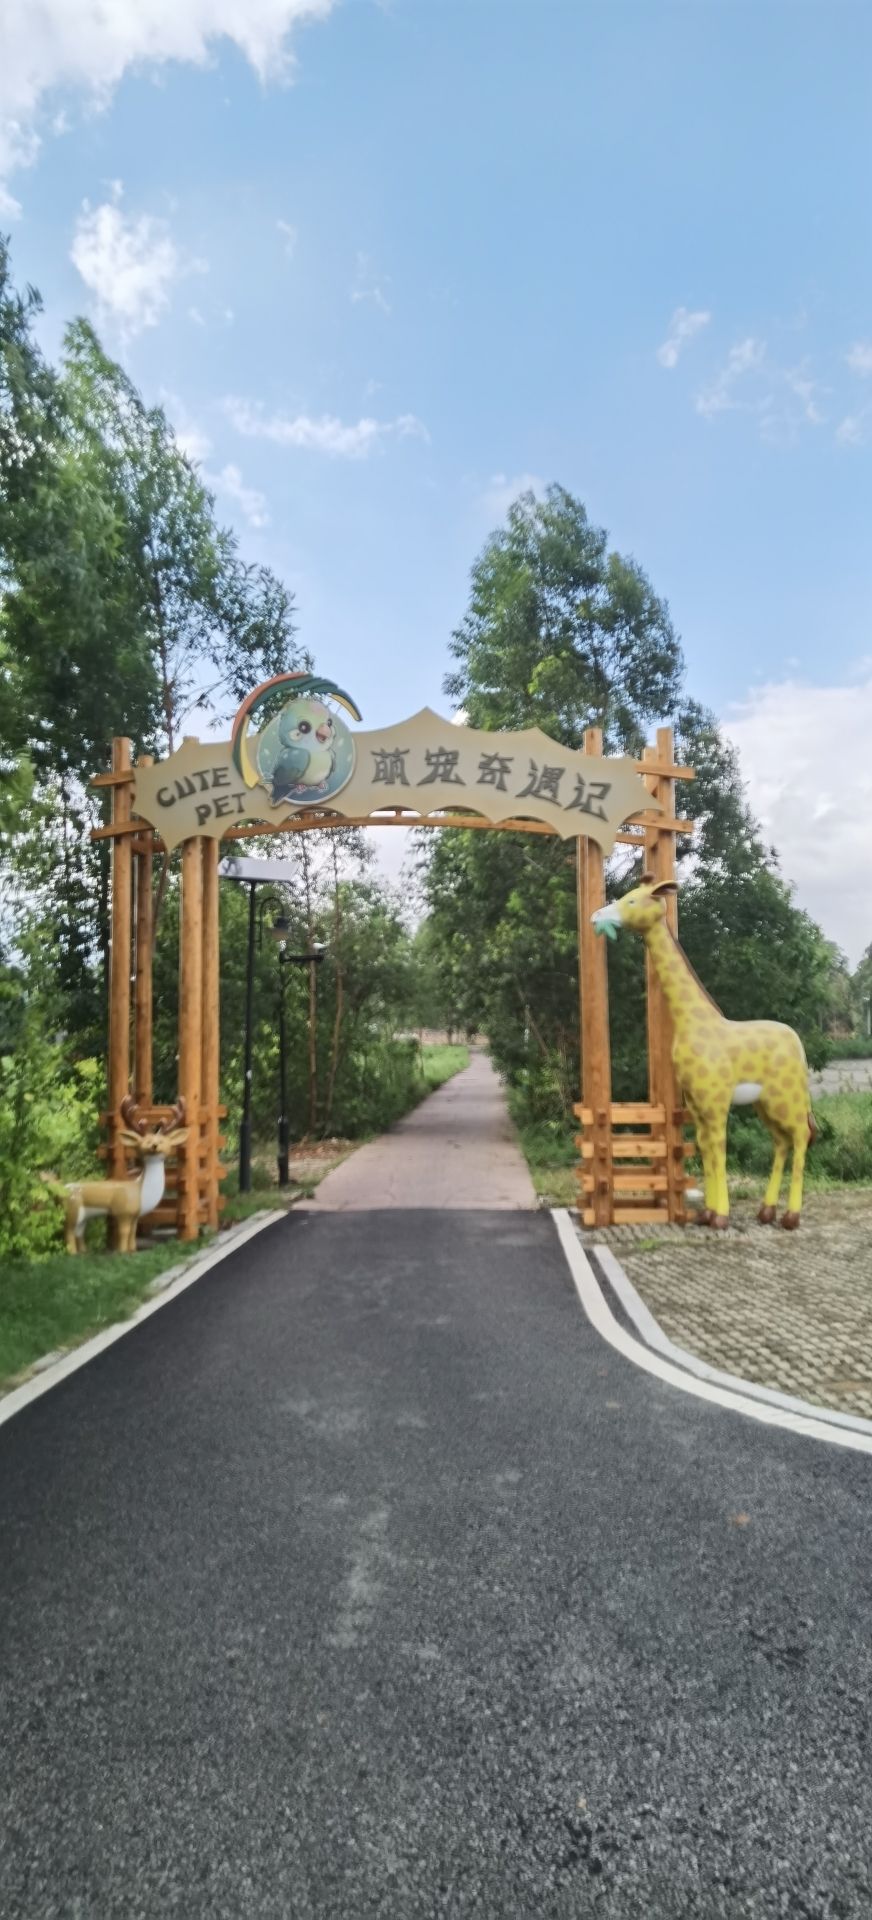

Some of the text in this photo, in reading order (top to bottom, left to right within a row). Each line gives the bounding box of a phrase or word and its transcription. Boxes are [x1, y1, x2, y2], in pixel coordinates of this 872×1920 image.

[156, 766, 231, 807] CUTE
[371, 746, 612, 823] 萌宠奇遇记
[195, 792, 246, 826] PET
